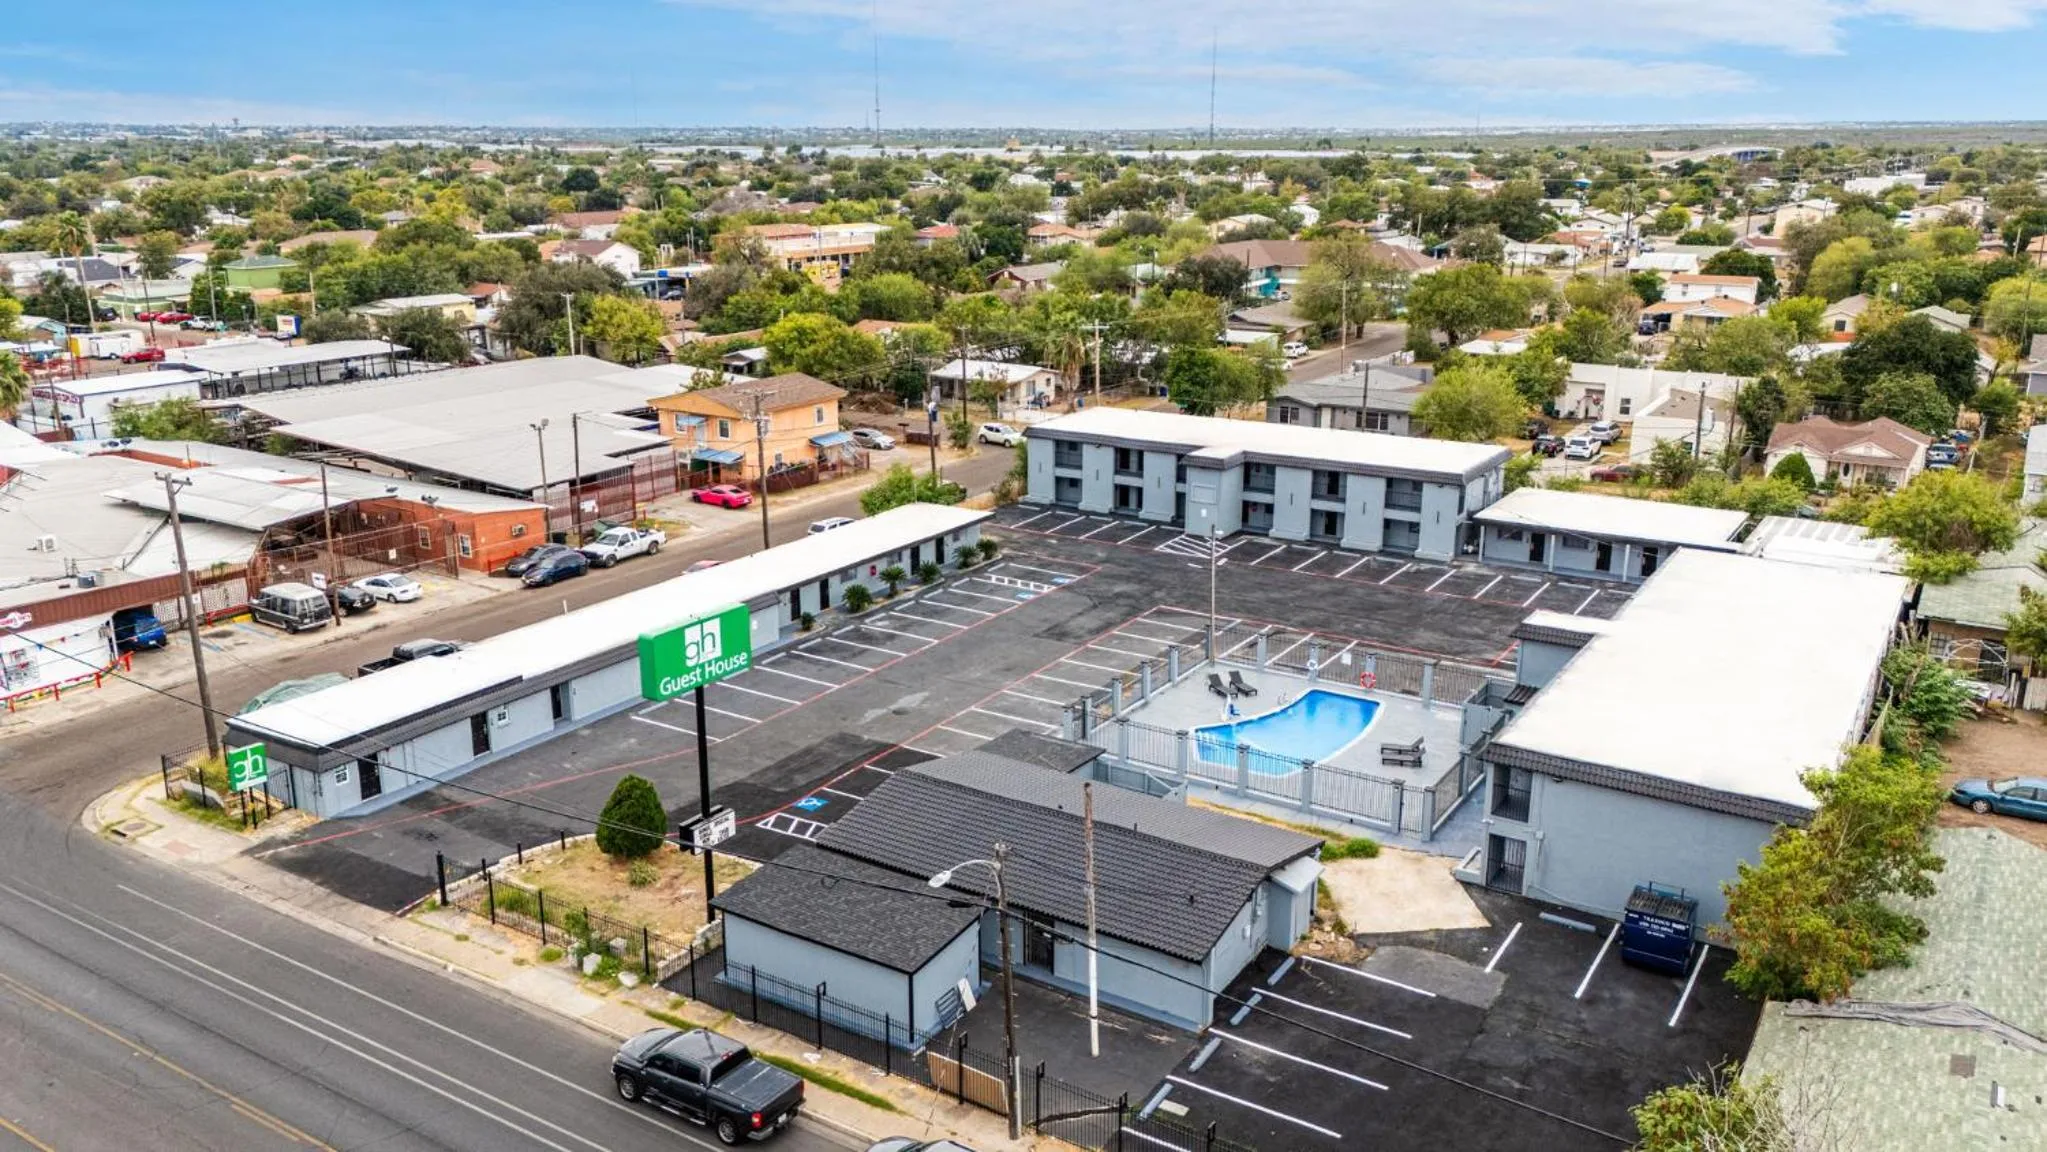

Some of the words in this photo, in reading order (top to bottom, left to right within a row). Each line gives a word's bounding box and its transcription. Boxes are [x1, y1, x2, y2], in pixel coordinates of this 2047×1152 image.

[685, 620, 719, 665] gh
[659, 668, 702, 696] Guest
[705, 651, 748, 679] House
